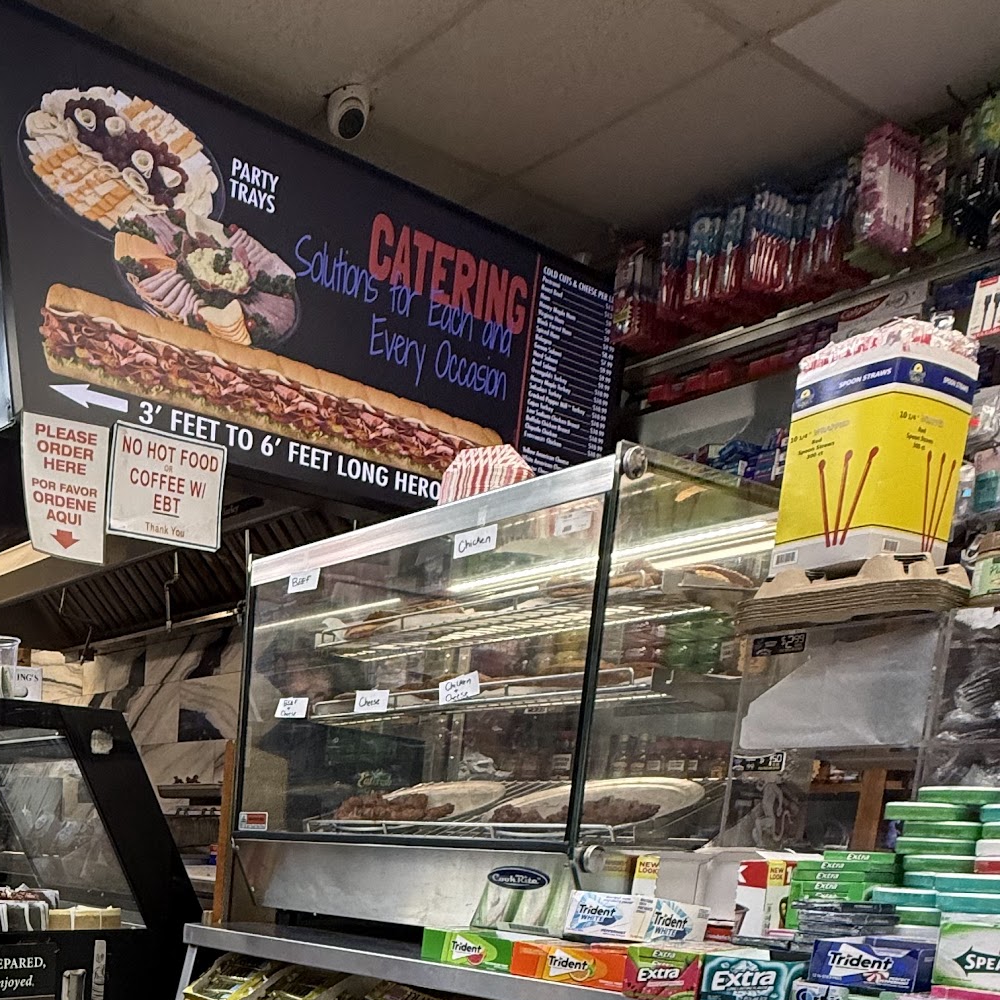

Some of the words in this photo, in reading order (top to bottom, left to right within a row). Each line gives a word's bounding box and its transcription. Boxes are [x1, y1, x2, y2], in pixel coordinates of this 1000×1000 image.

[232, 157, 280, 193] PARTY
[230, 179, 276, 214] TRAYS
[369, 214, 527, 334] CATERING
[543, 266, 558, 278] COLD
[559, 273, 572, 285] CUTS
[573, 280, 577, 288] &
[579, 282, 597, 296] CHEESE
[295, 235, 378, 303] Solutions
[389, 283, 421, 317] for
[428, 289, 473, 341] Each
[482, 318, 513, 356] and
[369, 314, 426, 386] Every
[435, 341, 507, 400] Occasion
[839, 377, 862, 388] SPOON
[863, 368, 892, 381] STRAWS
[35, 423, 97, 446] PLEASE
[37, 440, 94, 461] ORDER
[123, 436, 142, 455] NO
[148, 442, 176, 463] HOT
[180, 450, 219, 472] FOOD
[139, 401, 162, 425] 3'
[170, 409, 220, 441] FEET
[225, 424, 253, 450] TO
[260, 437, 281, 456] 6'
[288, 442, 332, 471] FEET
[337, 459, 389, 487] LONG
[394, 474, 441, 501] HERO
[44, 457, 86, 475] HERE
[32, 478, 56, 490] POR
[60, 484, 97, 497] FAVOR
[130, 468, 185, 494] COFFEE
[190, 480, 206, 499] W/
[33, 491, 96, 513] ORDENE
[153, 494, 180, 513] EBT
[47, 509, 82, 525] AQUI
[146, 522, 168, 534] Thank
[171, 526, 185, 537] You
[458, 535, 490, 553] Chicken
[359, 696, 380, 707] Cheese
[579, 904, 615, 915] Trident
[654, 912, 688, 928] Trident
[654, 927, 677, 936] WHITE
[451, 941, 481, 952] Trident
[653, 950, 675, 958] Extra
[549, 955, 588, 970] Trident
[829, 951, 892, 970] Trident
[637, 968, 680, 981] Extra
[711, 970, 776, 989] Extra
